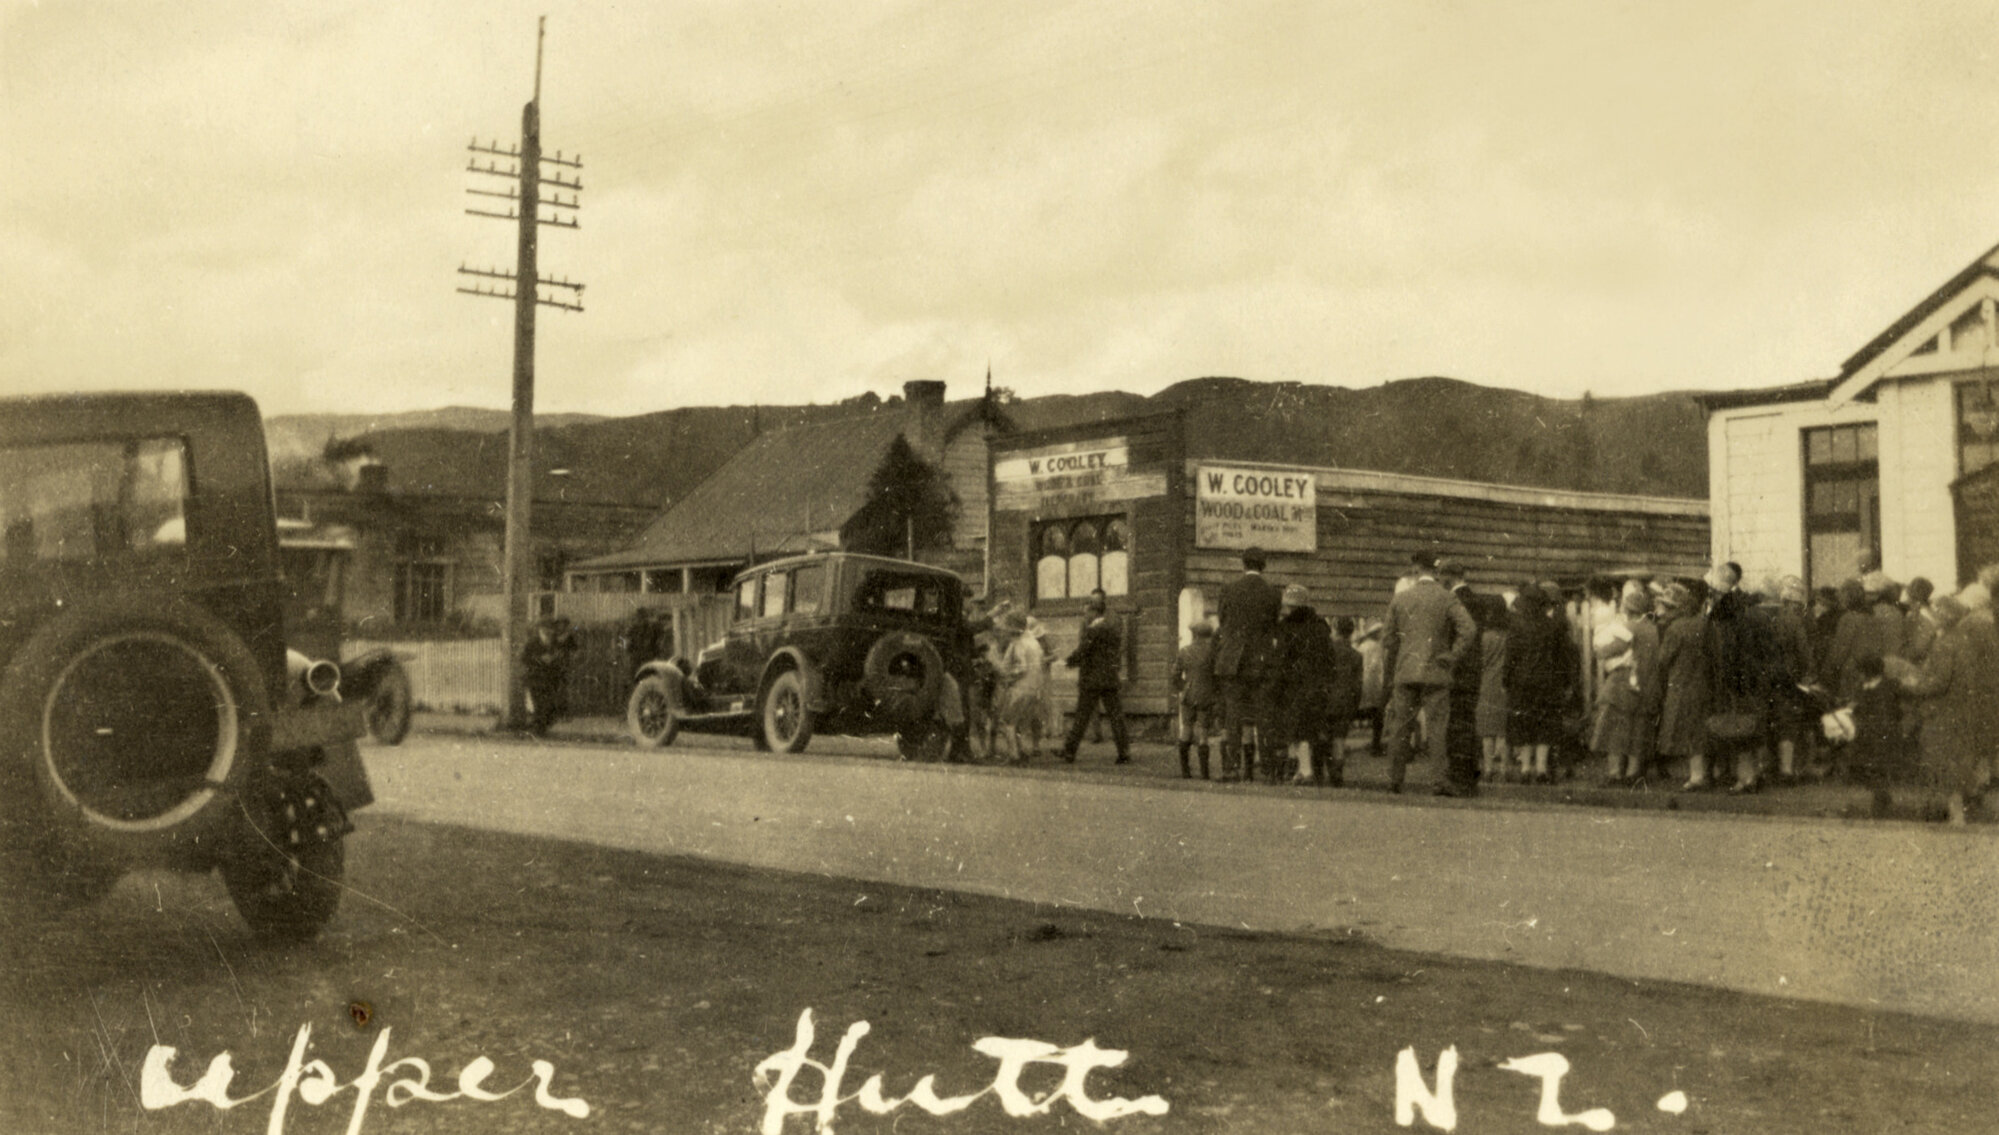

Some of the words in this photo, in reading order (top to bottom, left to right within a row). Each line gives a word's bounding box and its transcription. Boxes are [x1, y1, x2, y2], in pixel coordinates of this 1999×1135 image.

[1029, 460, 1043, 475] W.
[1208, 472, 1227, 494] W.
[1233, 474, 1308, 499] COOLEY
[1201, 500, 1244, 520] WOOD
[1253, 503, 1289, 522] COAL
